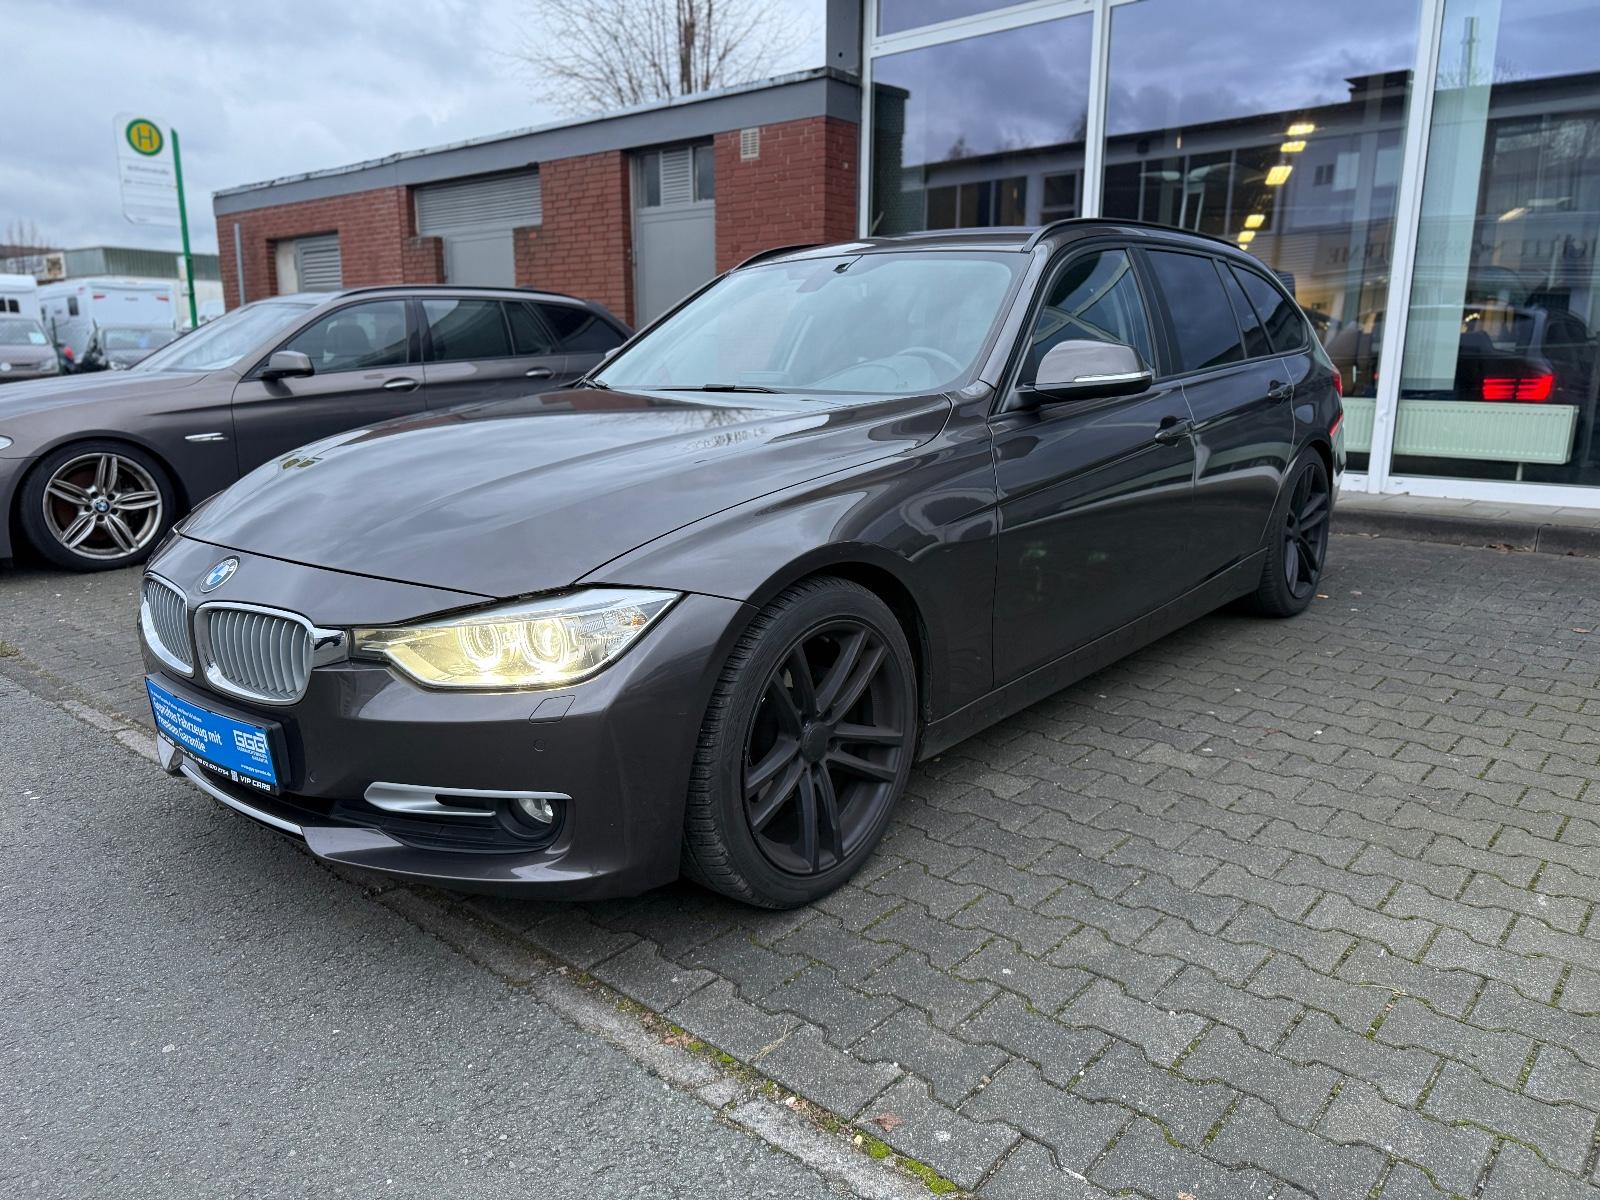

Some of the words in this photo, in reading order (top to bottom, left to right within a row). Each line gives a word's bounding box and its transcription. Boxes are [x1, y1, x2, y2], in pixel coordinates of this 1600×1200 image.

[137, 126, 154, 149] H
[208, 731, 223, 746] mit
[240, 775, 252, 784] VIP
[252, 779, 271, 792] CARS
